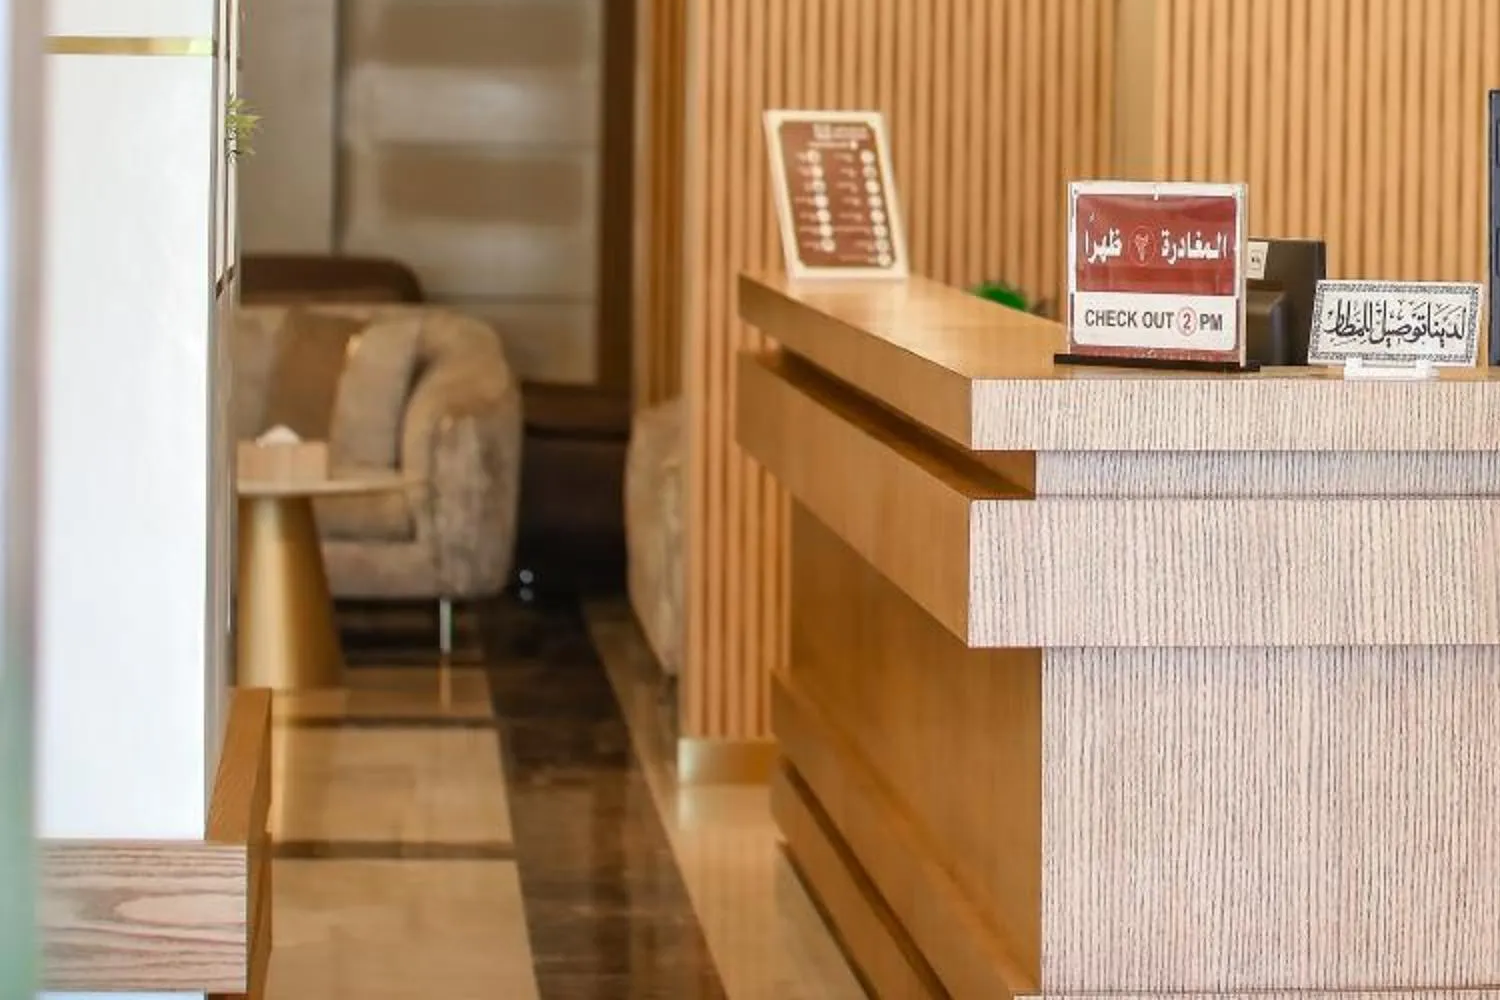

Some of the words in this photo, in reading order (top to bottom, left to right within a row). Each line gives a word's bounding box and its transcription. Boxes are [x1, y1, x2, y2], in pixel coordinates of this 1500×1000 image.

[1161, 228, 1228, 265] المغادرة
[1085, 308, 1137, 328] CHECK
[1142, 311, 1174, 329] OUT
[1200, 313, 1223, 331] PM
